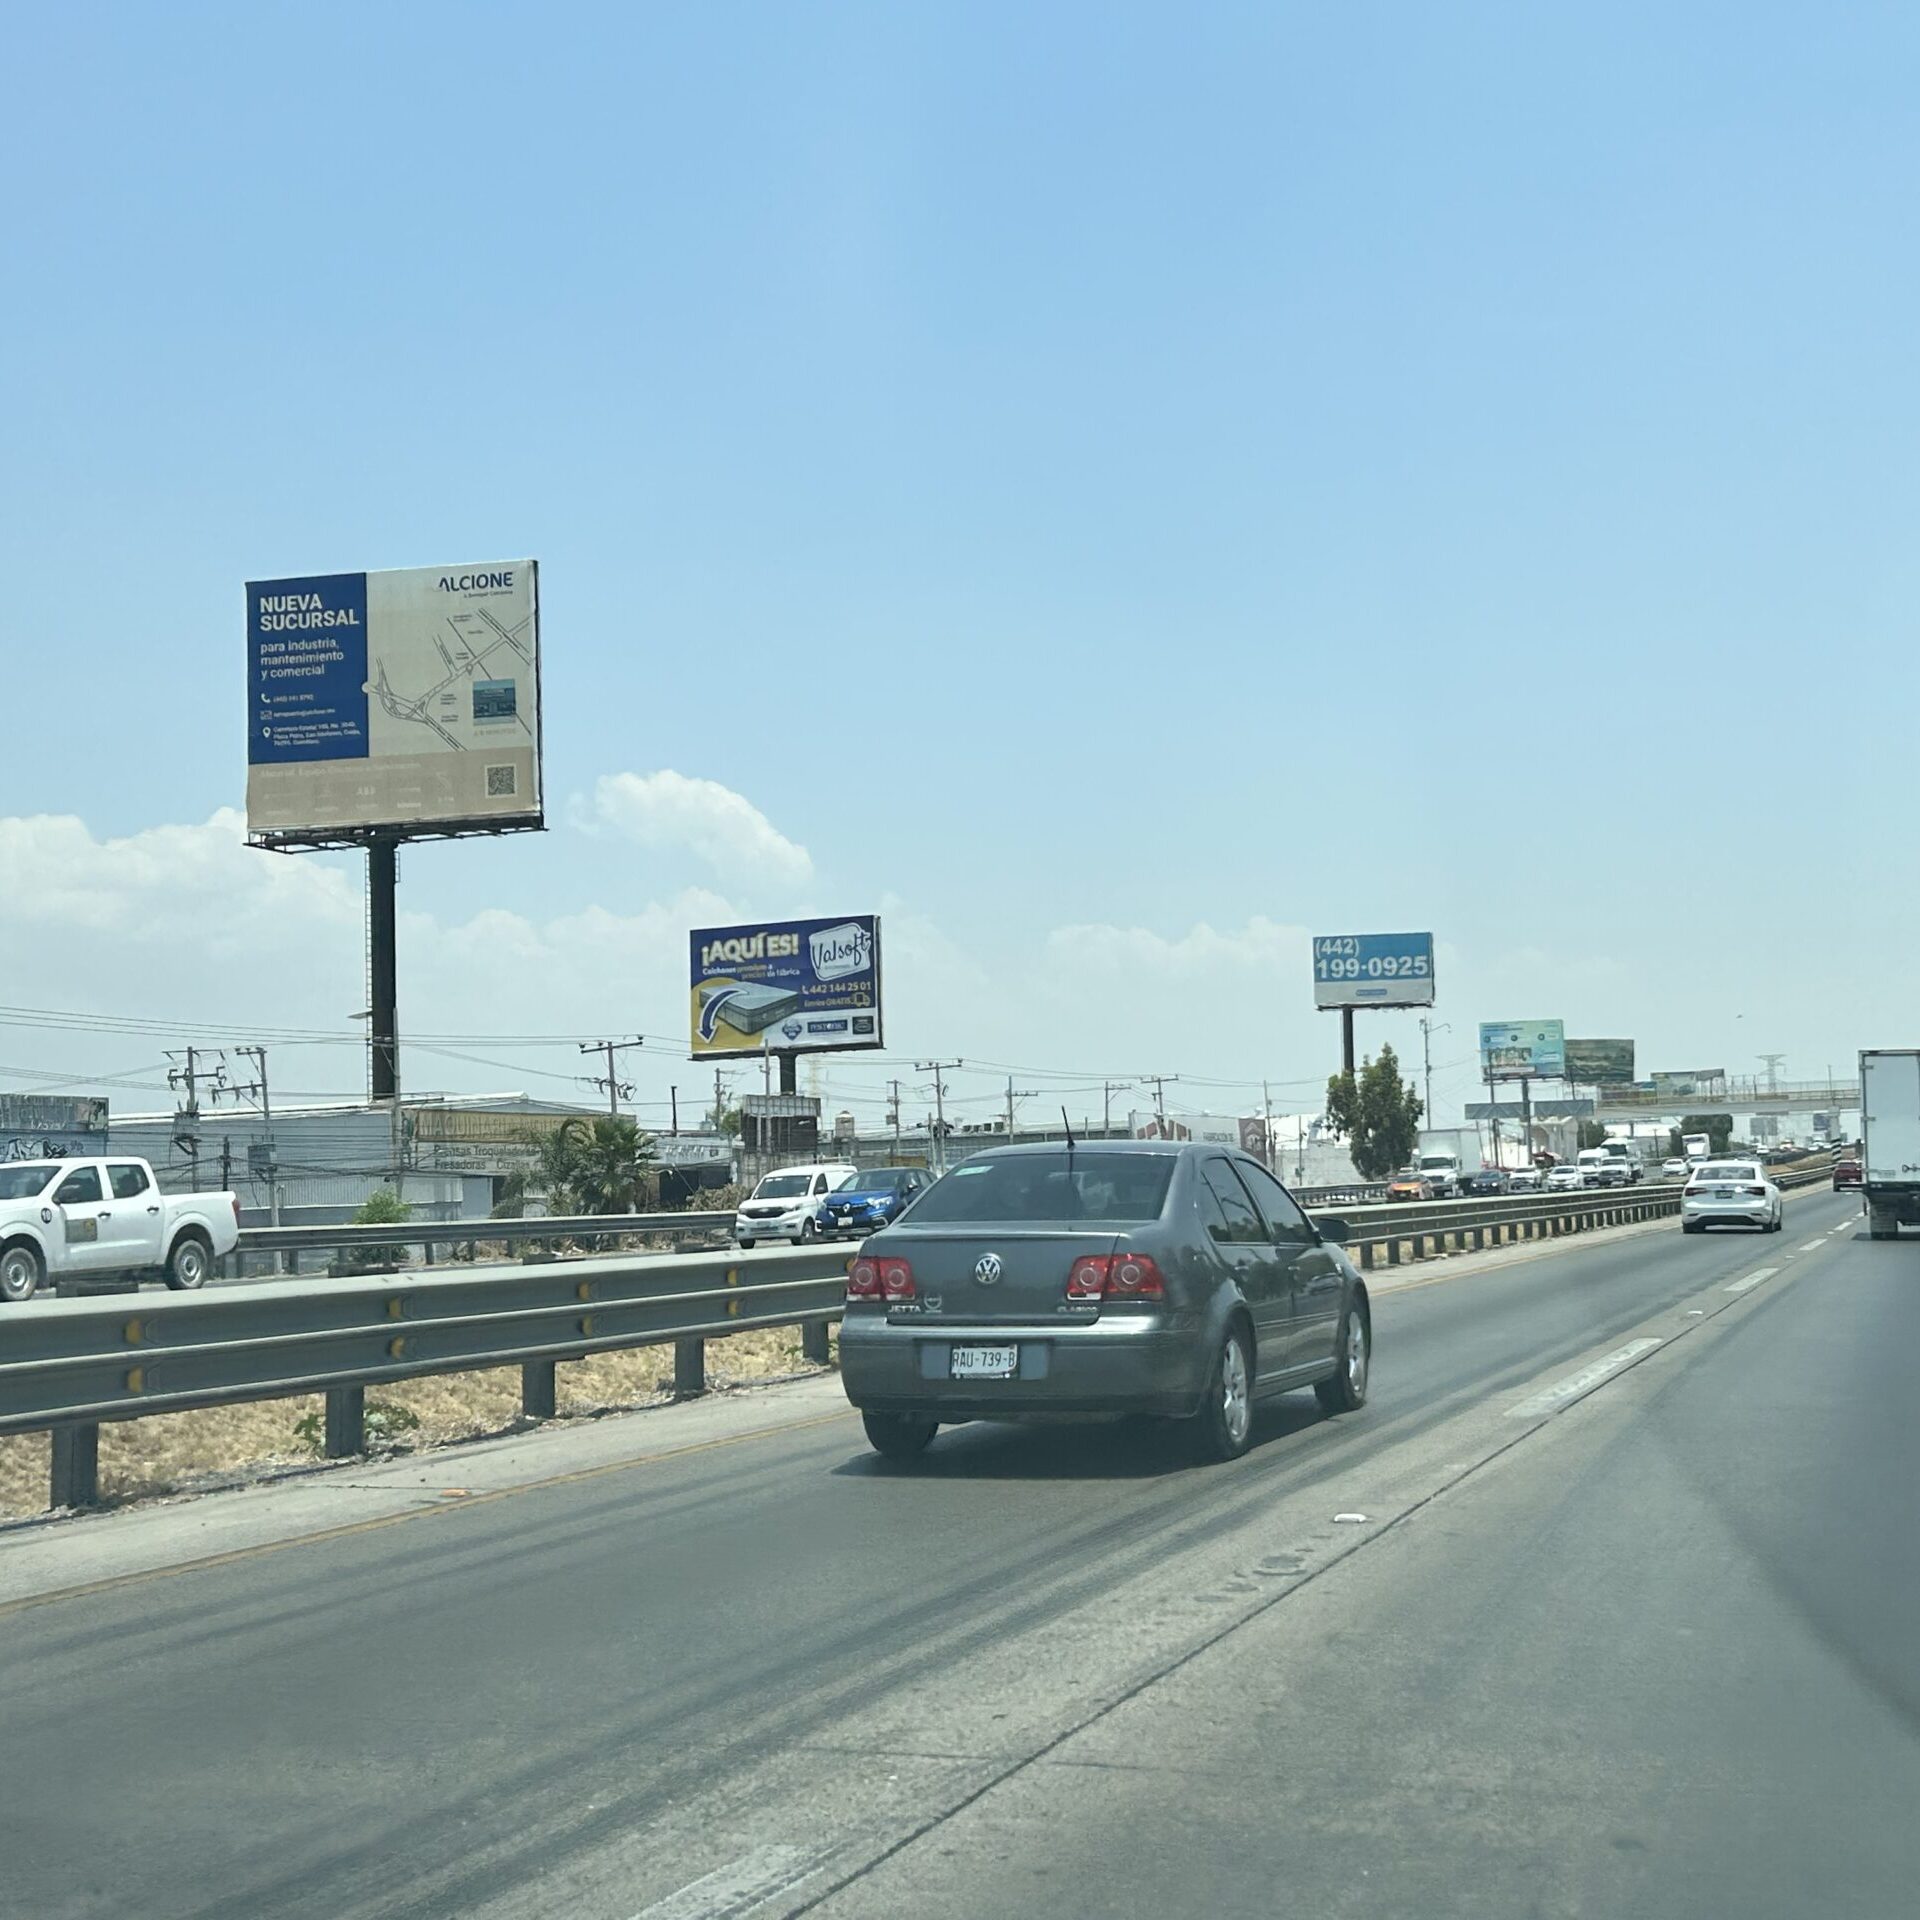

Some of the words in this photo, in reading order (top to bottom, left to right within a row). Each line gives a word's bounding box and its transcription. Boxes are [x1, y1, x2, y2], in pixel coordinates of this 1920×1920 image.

[439, 572, 514, 592] ALCIONE
[260, 594, 323, 613] NUEVA
[260, 609, 360, 631] SUCURSAL
[260, 643, 285, 655] para
[260, 651, 344, 666] mantenimiento
[261, 670, 268, 680] y
[270, 664, 325, 678] comercial
[702, 932, 767, 967] ¡AQUÍ
[767, 933, 799, 957] ES!
[812, 930, 872, 970] Valsoft
[1316, 938, 1359, 959] (442)
[702, 966, 737, 976] Colchones
[1317, 956, 1428, 979] 199-0925
[809, 984, 827, 993] 442
[830, 983, 847, 992] 144
[849, 982, 860, 991] 25
[860, 981, 871, 990] 01
[434, 1159, 486, 1170] Fresadoras
[888, 1304, 921, 1313] JETTA
[952, 1351, 1016, 1368] RAU-739-B
